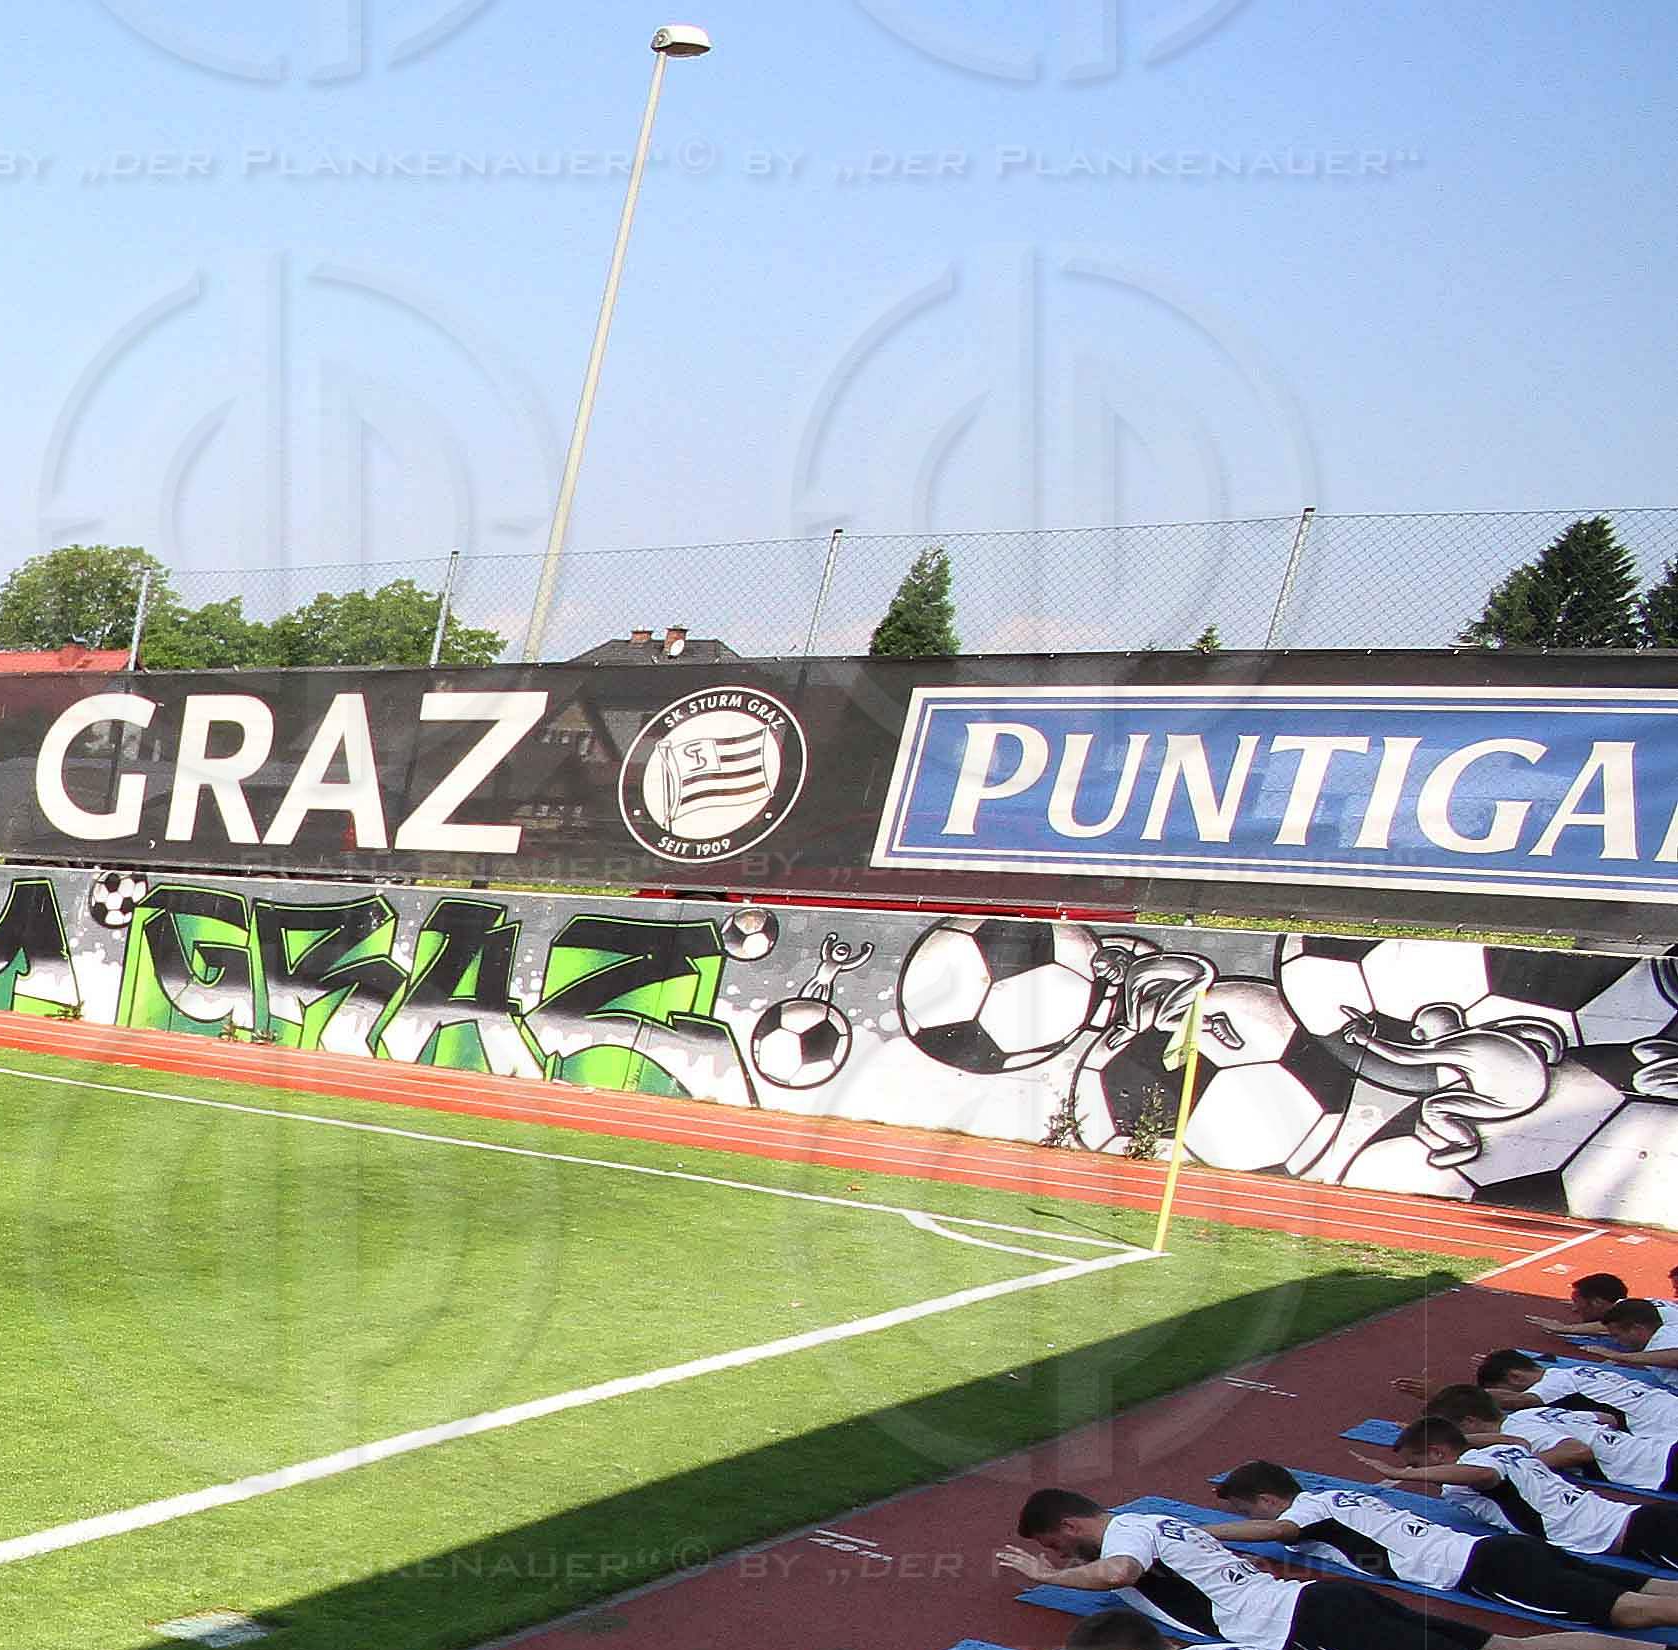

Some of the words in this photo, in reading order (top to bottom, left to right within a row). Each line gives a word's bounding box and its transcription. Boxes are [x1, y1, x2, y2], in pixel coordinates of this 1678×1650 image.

[664, 710, 684, 728] SK
[689, 694, 743, 713] STURM
[746, 698, 786, 730] GRAZ
[34, 690, 550, 854] GRAZ
[940, 720, 1678, 862] PUNTIGA
[658, 836, 693, 855] SEIT
[696, 838, 731, 856] 1909
